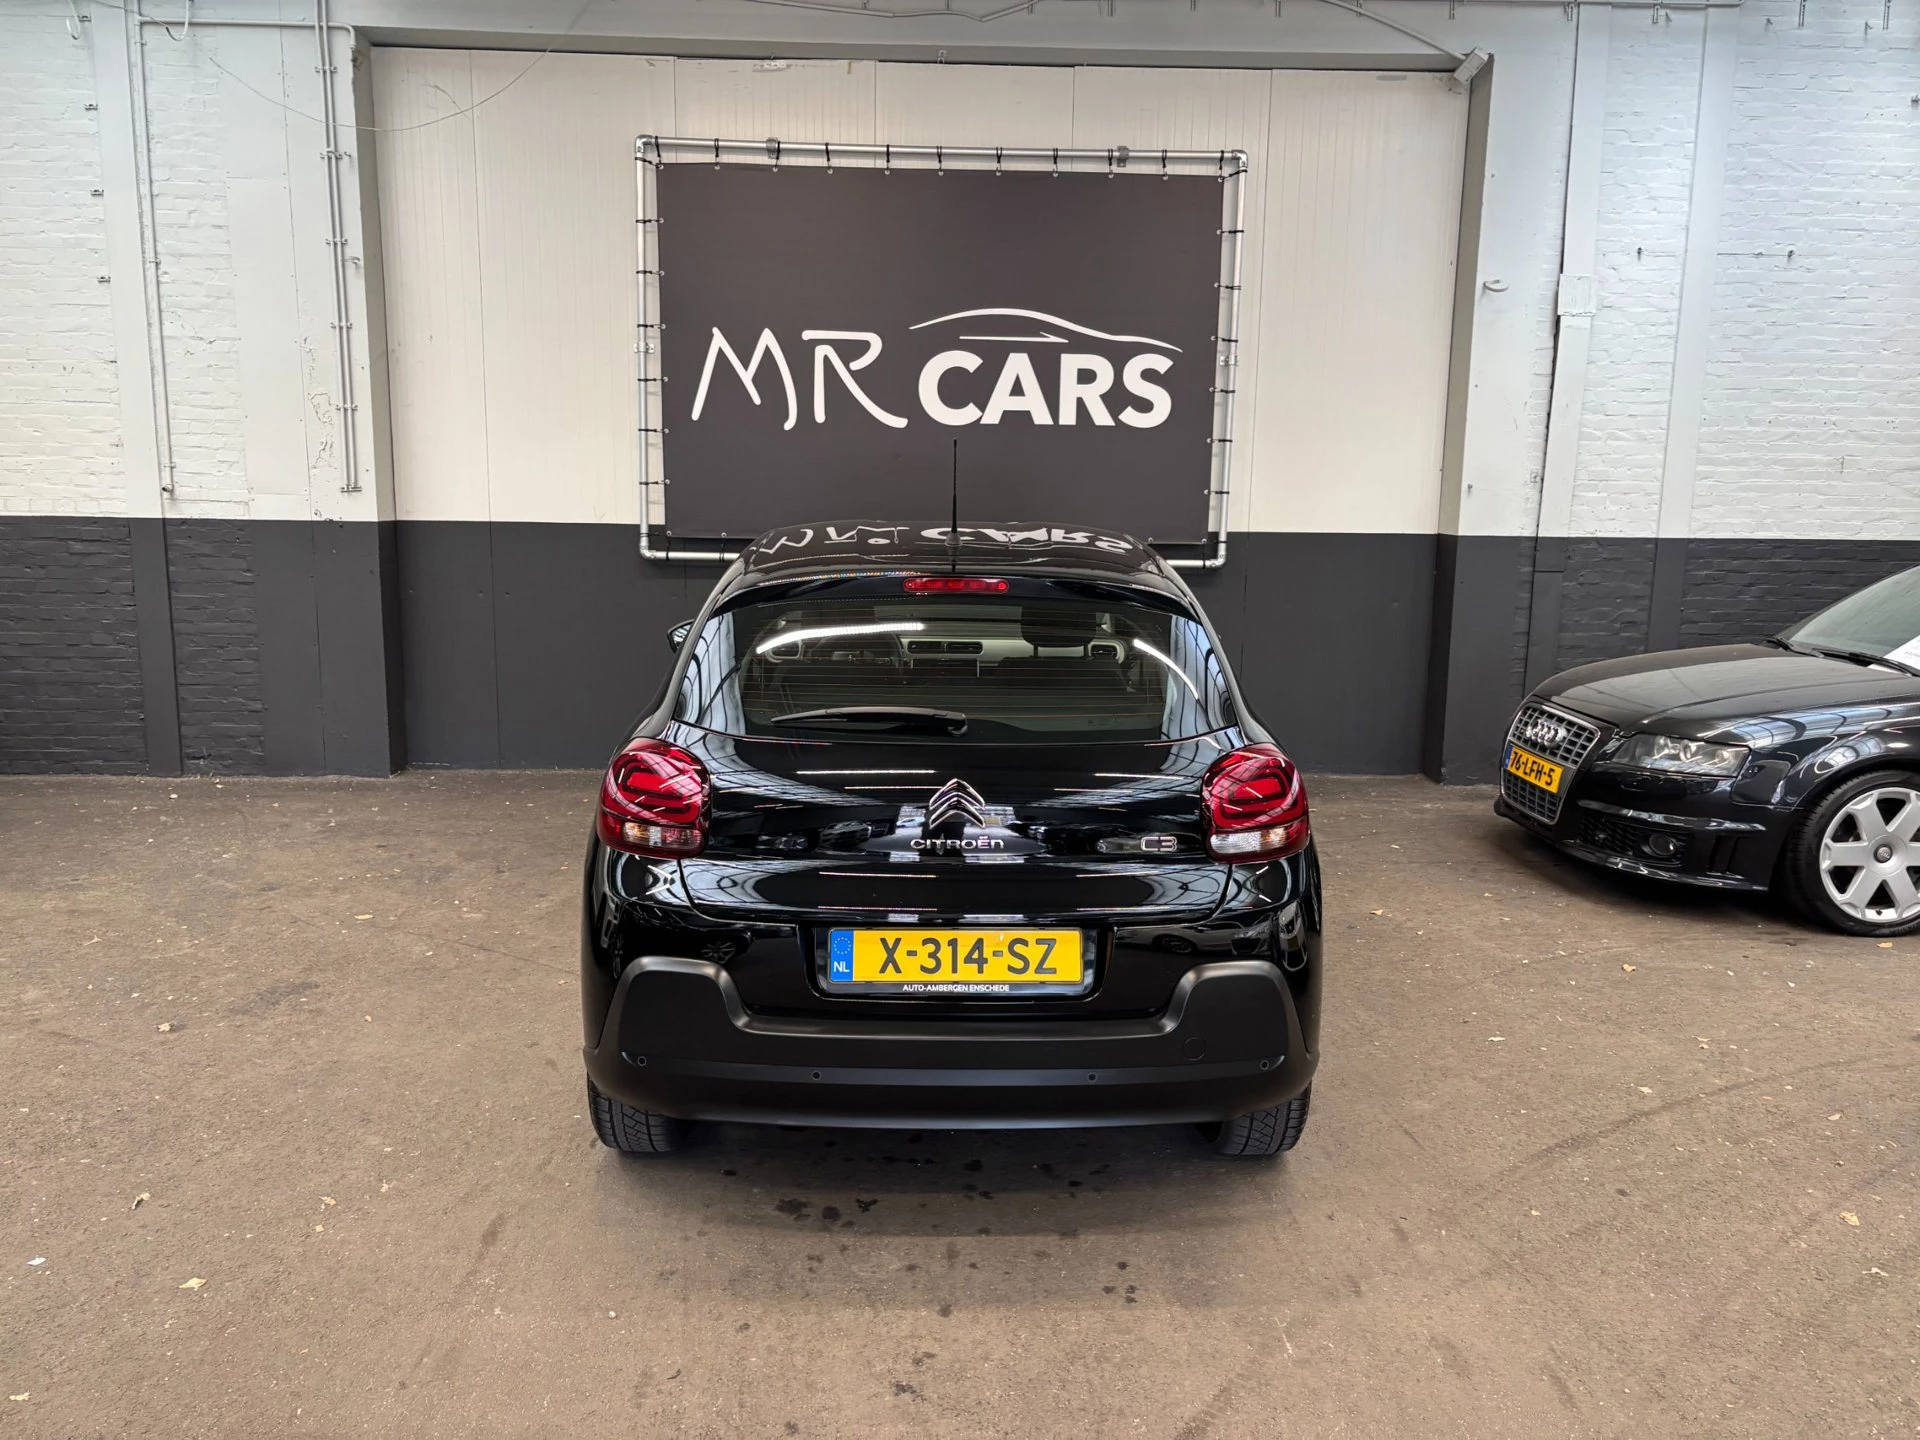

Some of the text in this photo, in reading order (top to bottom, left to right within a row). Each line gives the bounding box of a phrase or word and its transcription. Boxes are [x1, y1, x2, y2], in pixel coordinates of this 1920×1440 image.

[691, 327, 1175, 431] MR CARS
[1510, 750, 1555, 786] 76-LFH-5
[1140, 836, 1177, 852] C3
[833, 960, 851, 973] NL
[878, 937, 1058, 975] X-314-SZ
[902, 983, 1010, 992] AUTO-AMBERGEN ENSCHEDE
